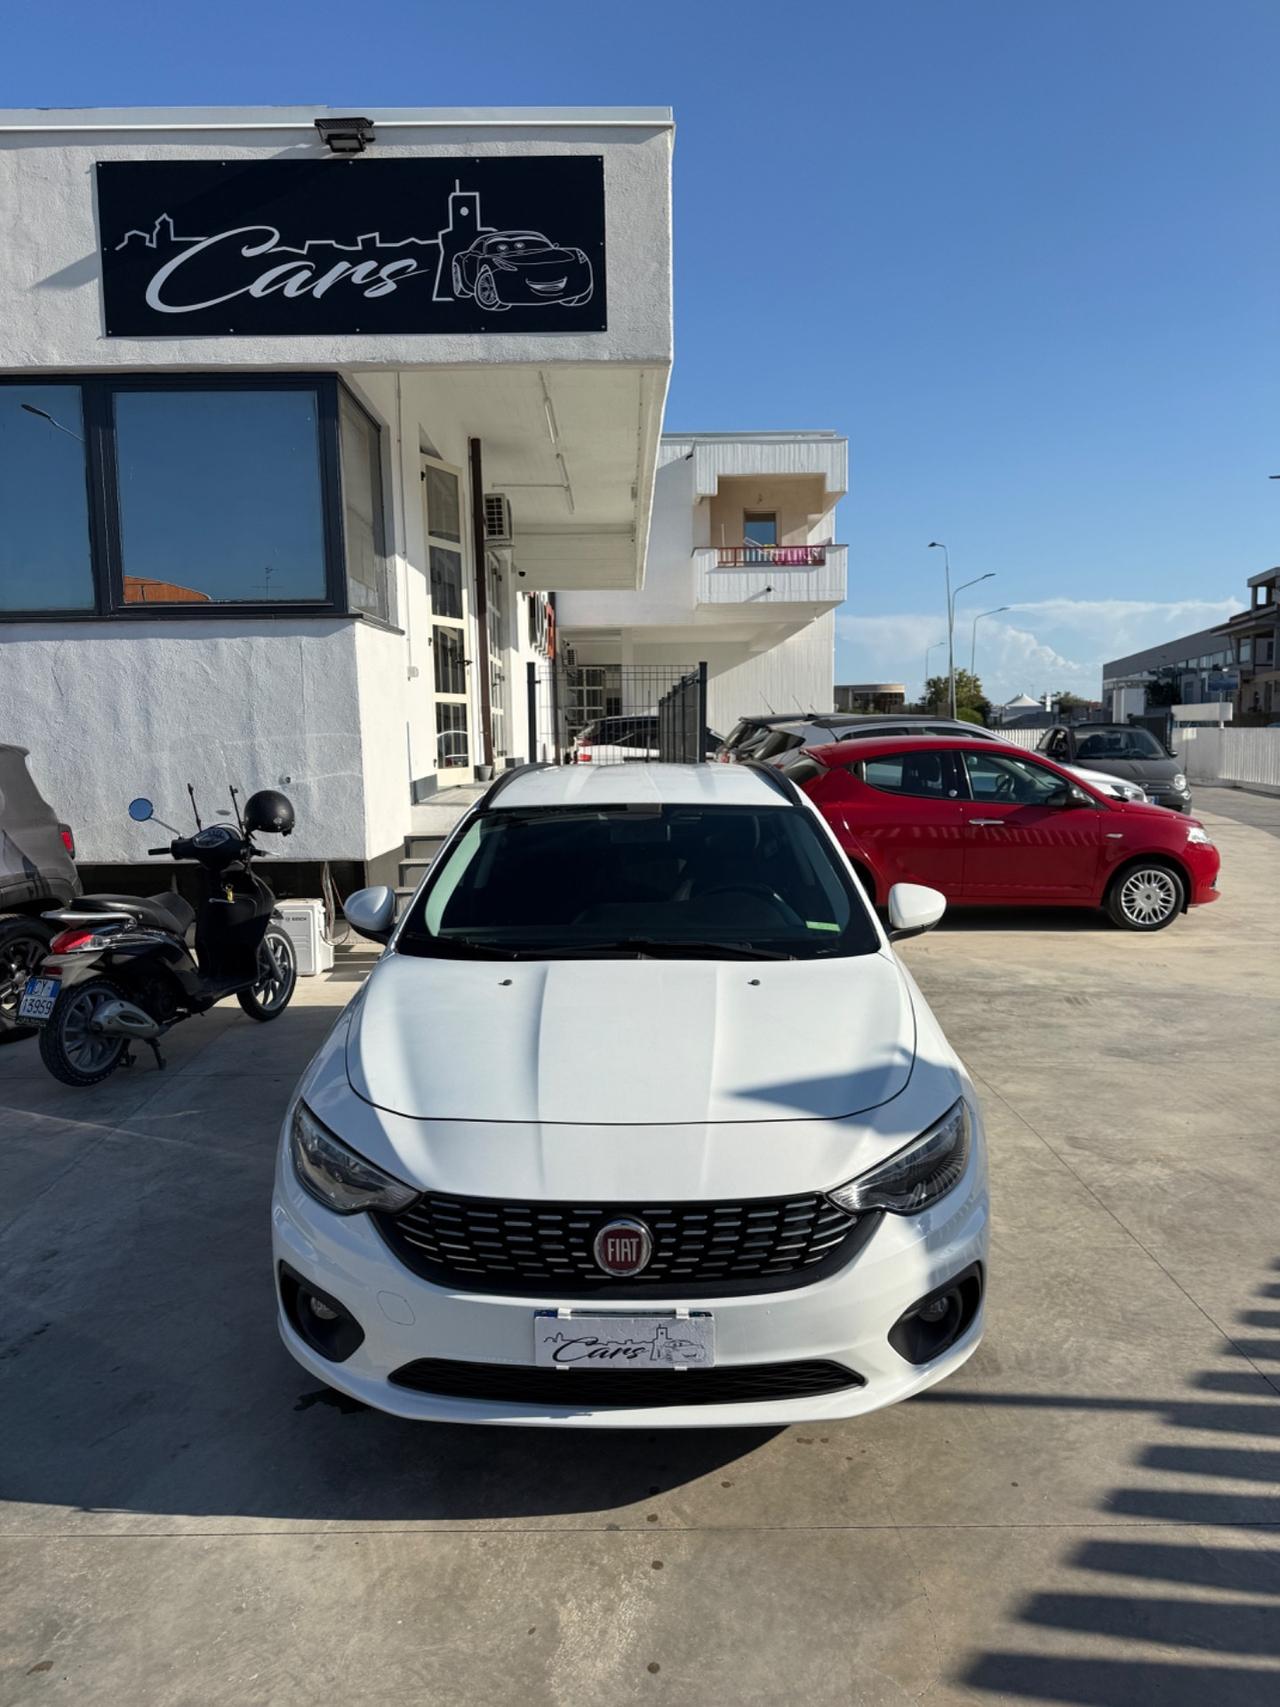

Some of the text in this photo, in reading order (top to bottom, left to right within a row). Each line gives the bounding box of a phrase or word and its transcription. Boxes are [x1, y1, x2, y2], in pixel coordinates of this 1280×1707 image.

[145, 225, 430, 313] Cars
[22, 998, 52, 1015] 13959
[607, 1238, 639, 1262] FIAT
[552, 1336, 648, 1363] Cars
